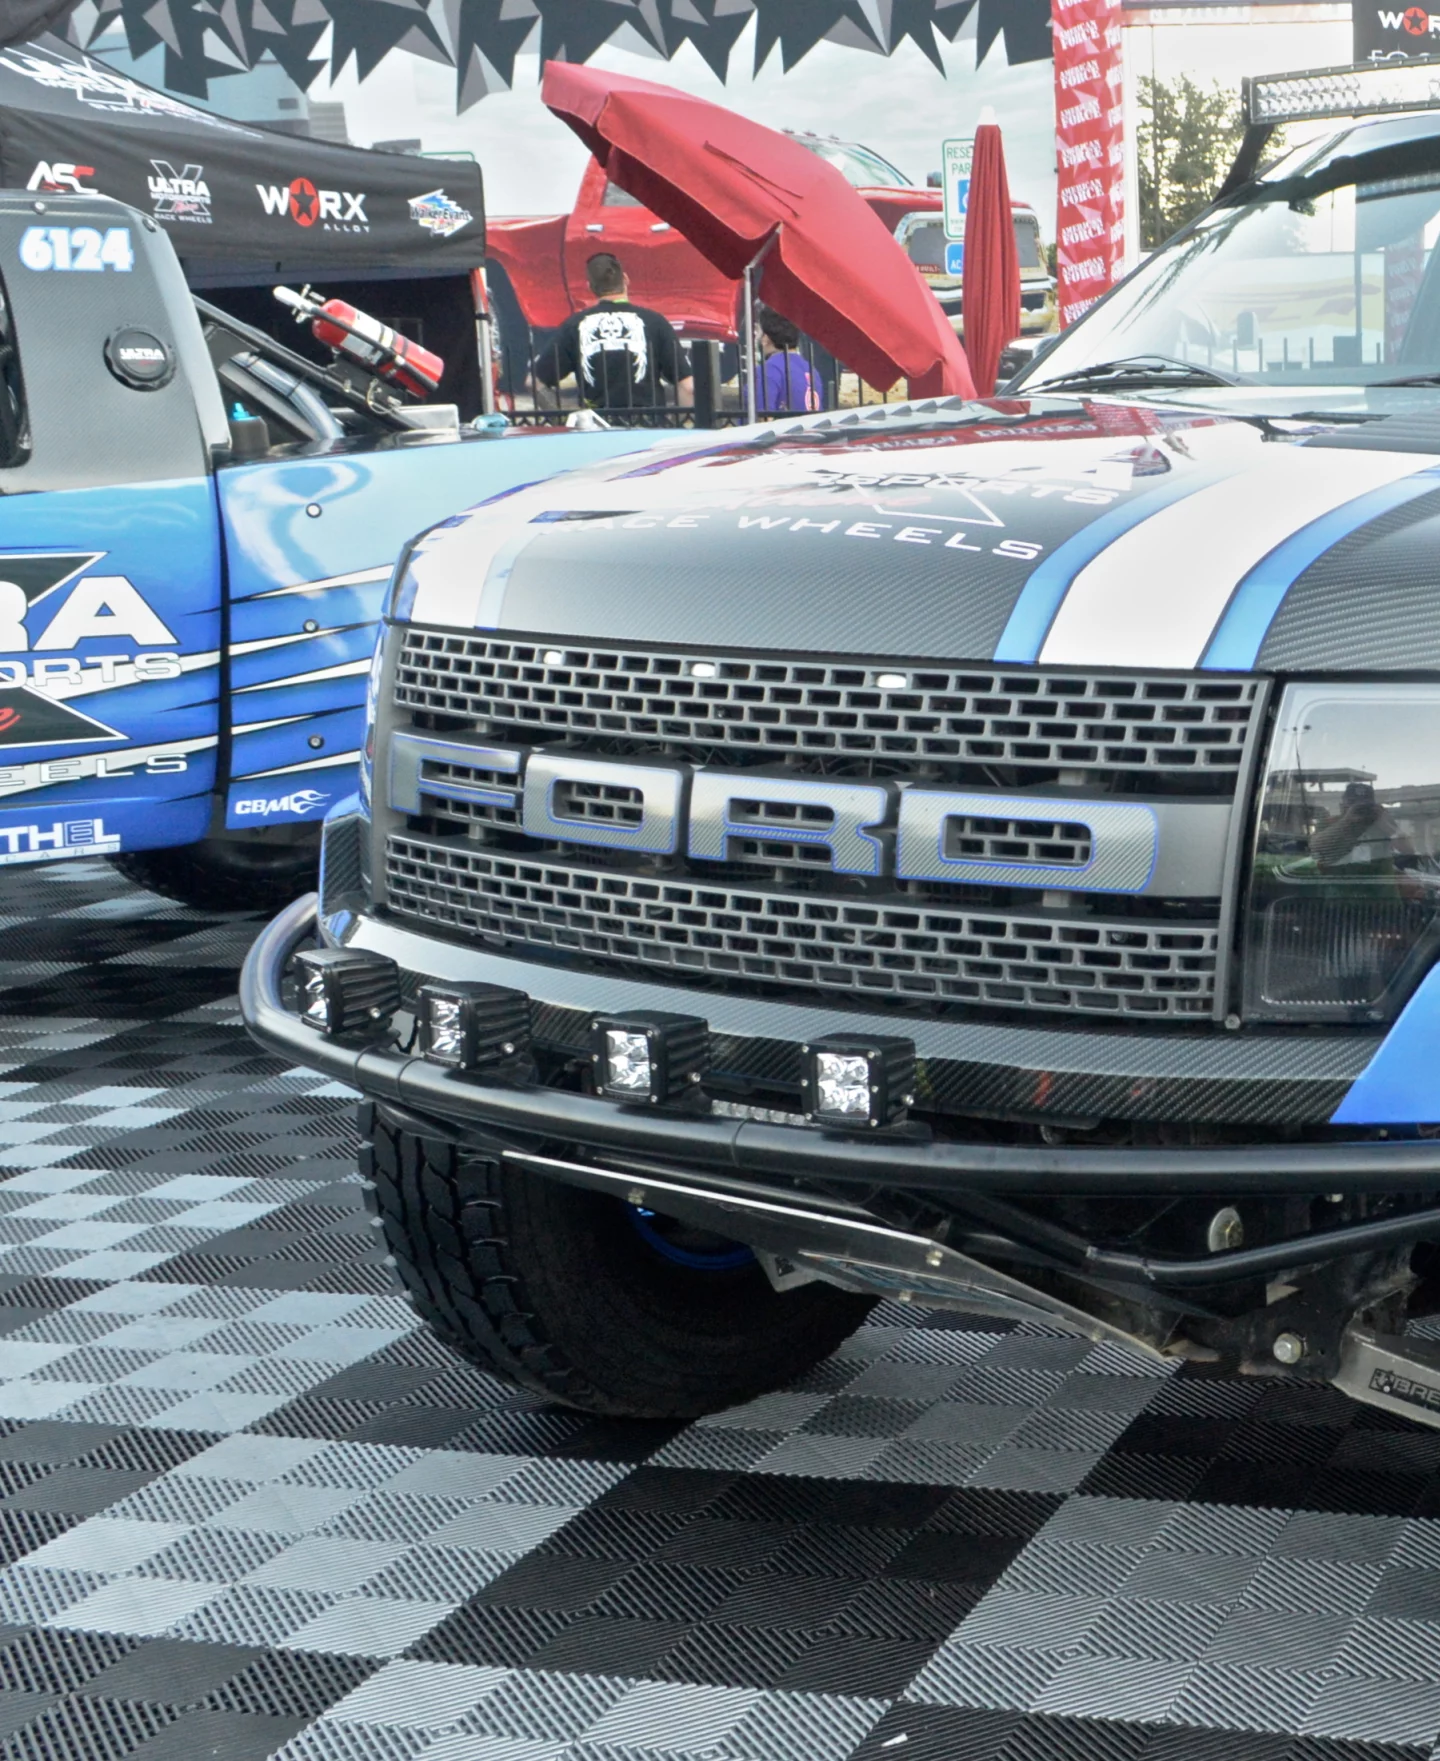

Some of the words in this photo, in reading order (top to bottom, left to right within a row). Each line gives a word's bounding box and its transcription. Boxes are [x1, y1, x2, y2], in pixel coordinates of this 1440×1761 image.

[147, 176, 211, 198] ULTRA
[19, 226, 134, 272] 6124
[323, 222, 371, 233] ALLOY
[738, 515, 1043, 561] WHEELS
[390, 731, 1160, 893] FORD
